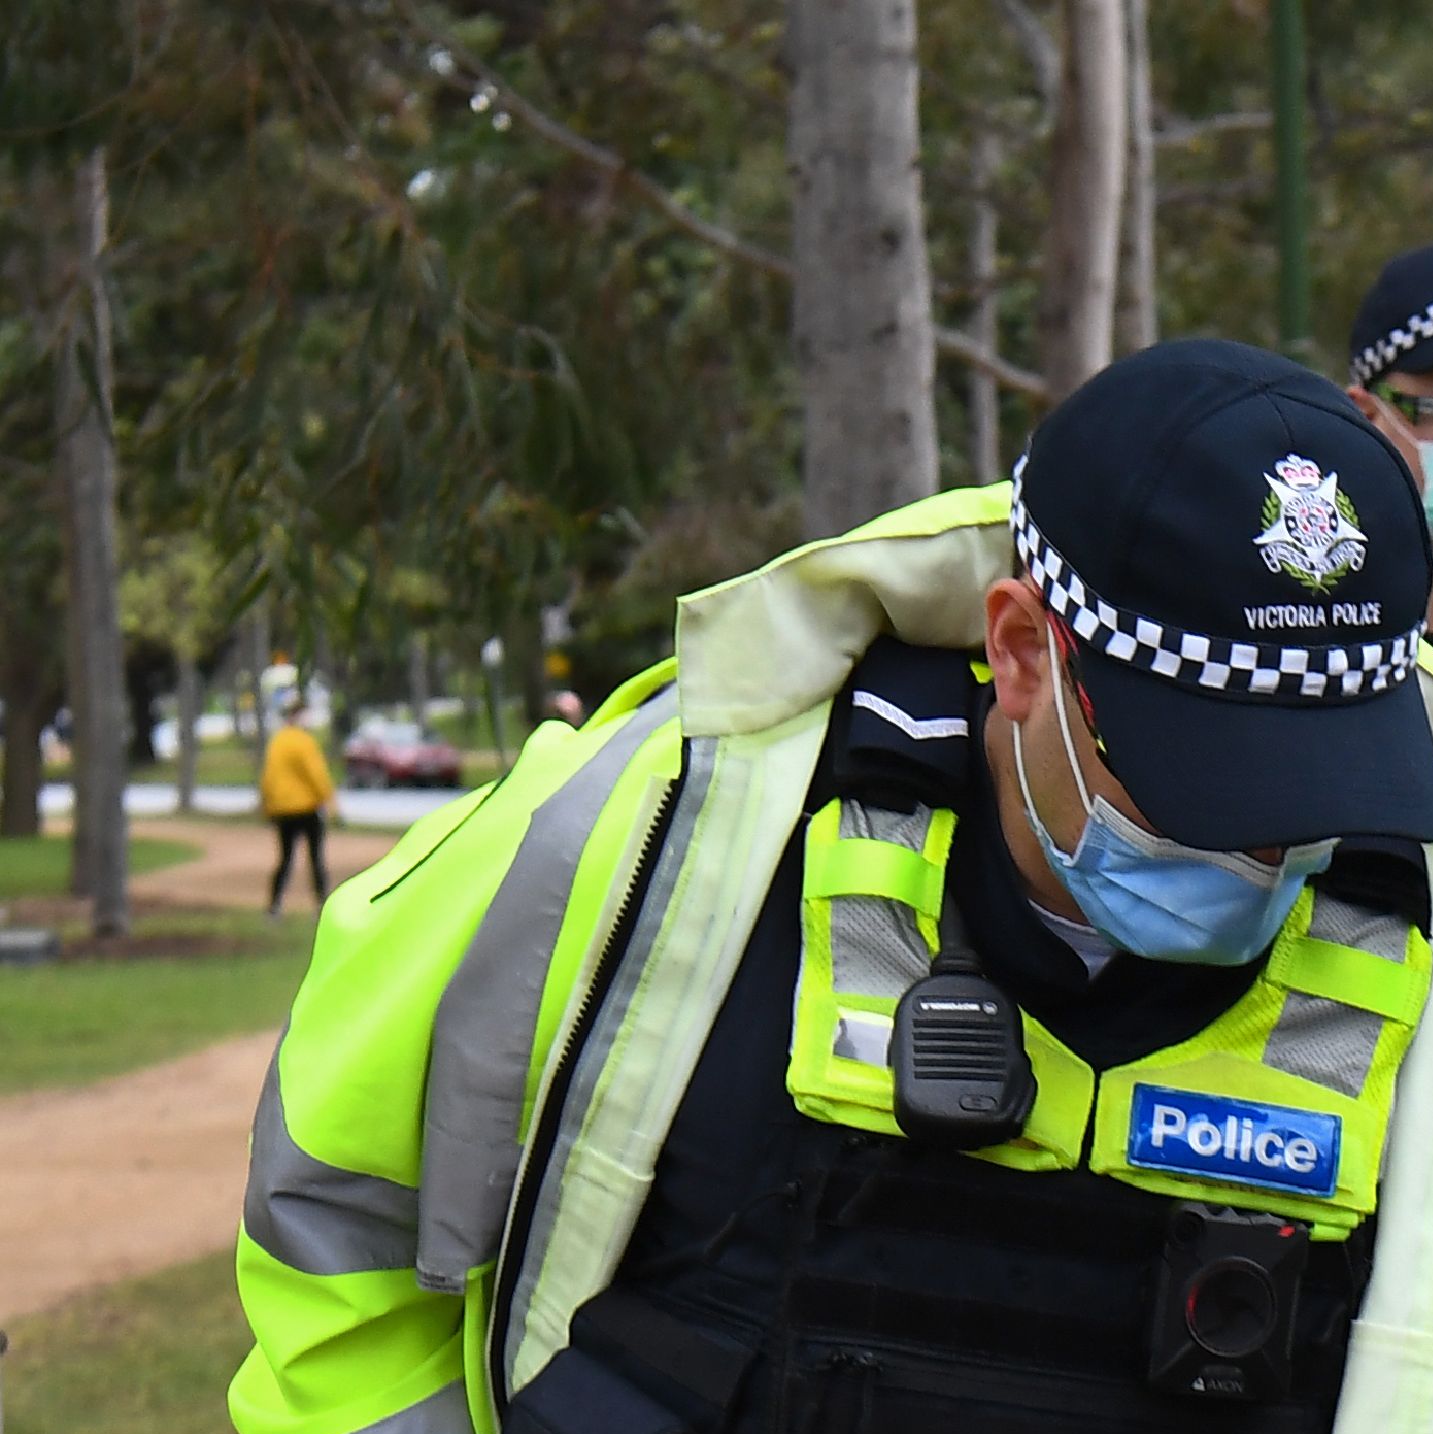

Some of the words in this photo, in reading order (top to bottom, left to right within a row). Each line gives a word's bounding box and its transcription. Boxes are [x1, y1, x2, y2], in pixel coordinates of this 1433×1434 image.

[1243, 604, 1326, 630] VICTORIA
[1332, 602, 1382, 627] POLICE
[1150, 1103, 1318, 1173] Police
